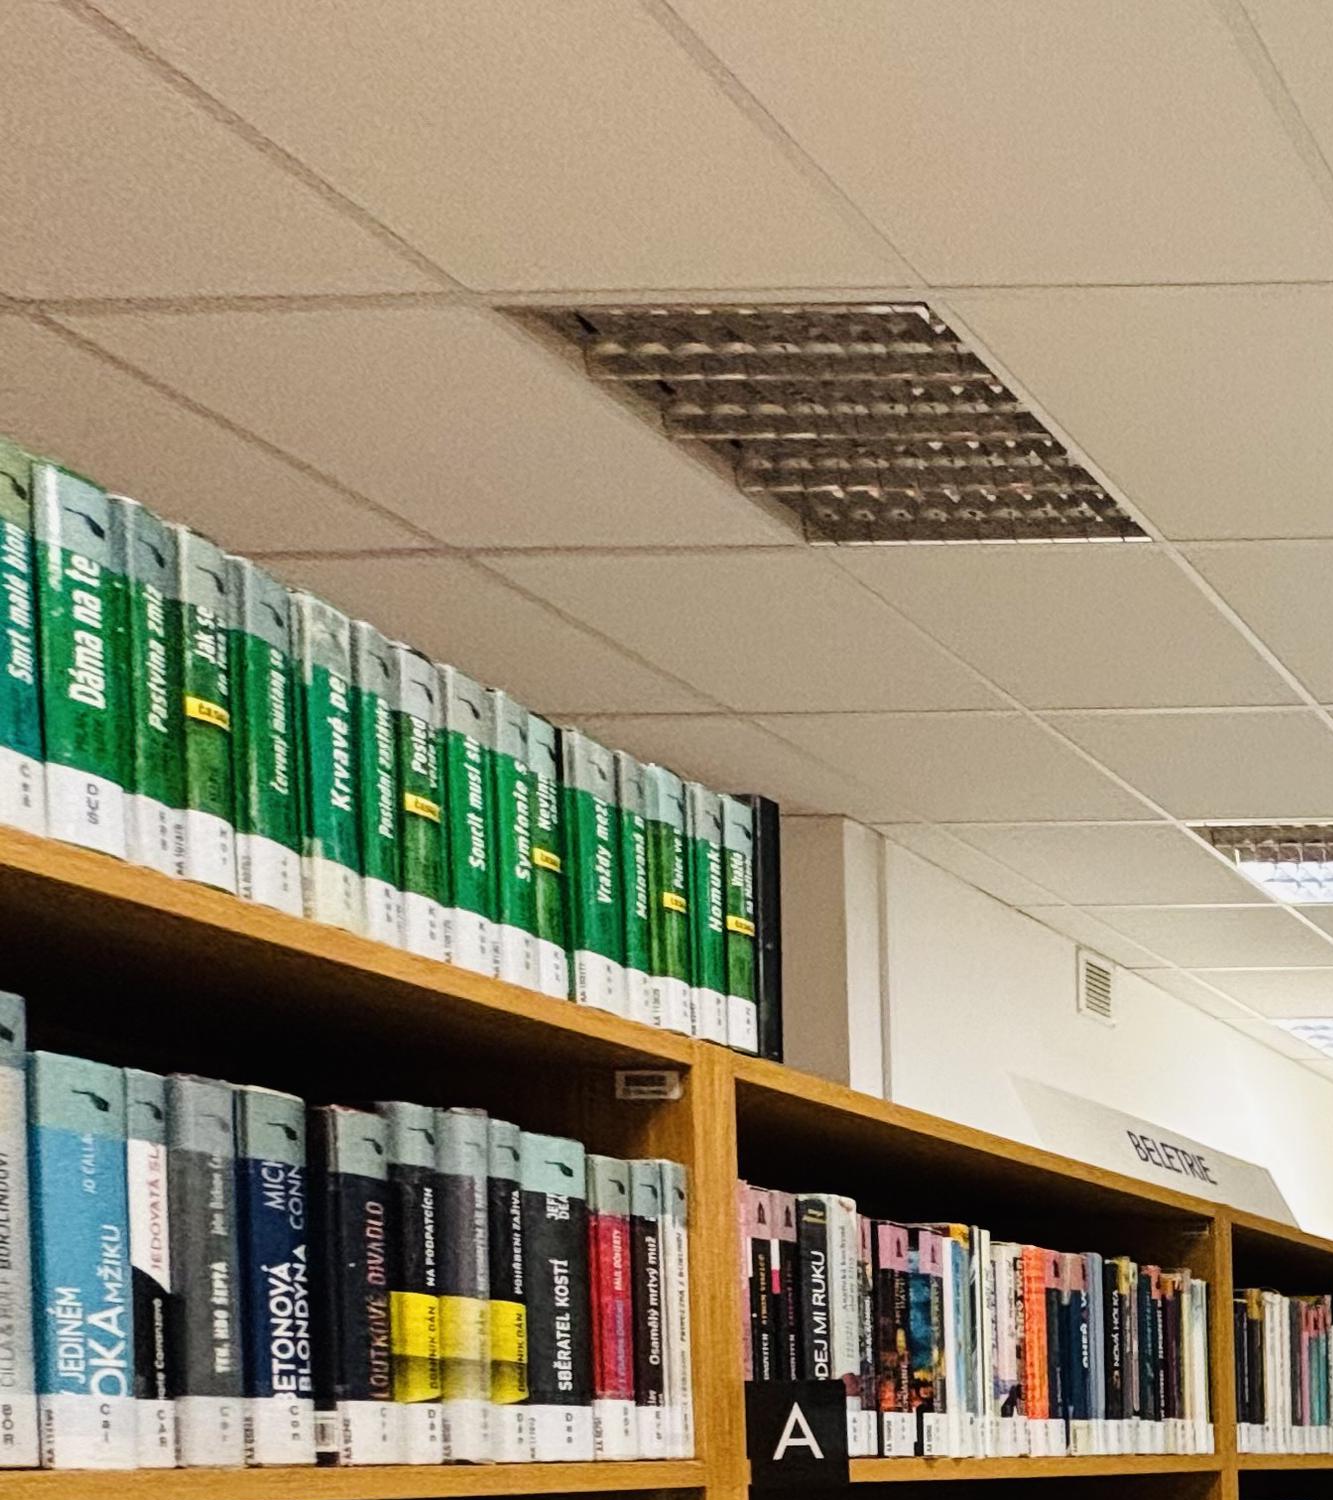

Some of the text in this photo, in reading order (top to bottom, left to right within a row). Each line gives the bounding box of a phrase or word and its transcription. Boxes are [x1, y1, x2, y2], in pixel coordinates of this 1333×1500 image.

[70, 588, 104, 627] na
[195, 629, 218, 664] Jak
[7, 629, 34, 685] Smrt
[68, 628, 107, 710] Dáma
[146, 637, 169, 734] Pastvina
[326, 715, 353, 812] Krvavé
[467, 811, 487, 872] Soucit
[512, 780, 533, 883] Symfonie
[595, 847, 613, 905] Vraždy
[1126, 1130, 1218, 1185] BELETRIE
[365, 1200, 386, 1287] DIVADLO
[47, 1286, 86, 1385] JEDINÉM
[261, 1262, 299, 1402] BETONOVÁ
[291, 1244, 312, 1392] BLONDYNA
[549, 1257, 574, 1391] SBĚRATEL KOSTÍ
[644, 1236, 660, 1366] Osamělý mrtvý muž
[809, 1250, 829, 1380] DEJ MI RUKU
[772, 1402, 825, 1460] A
